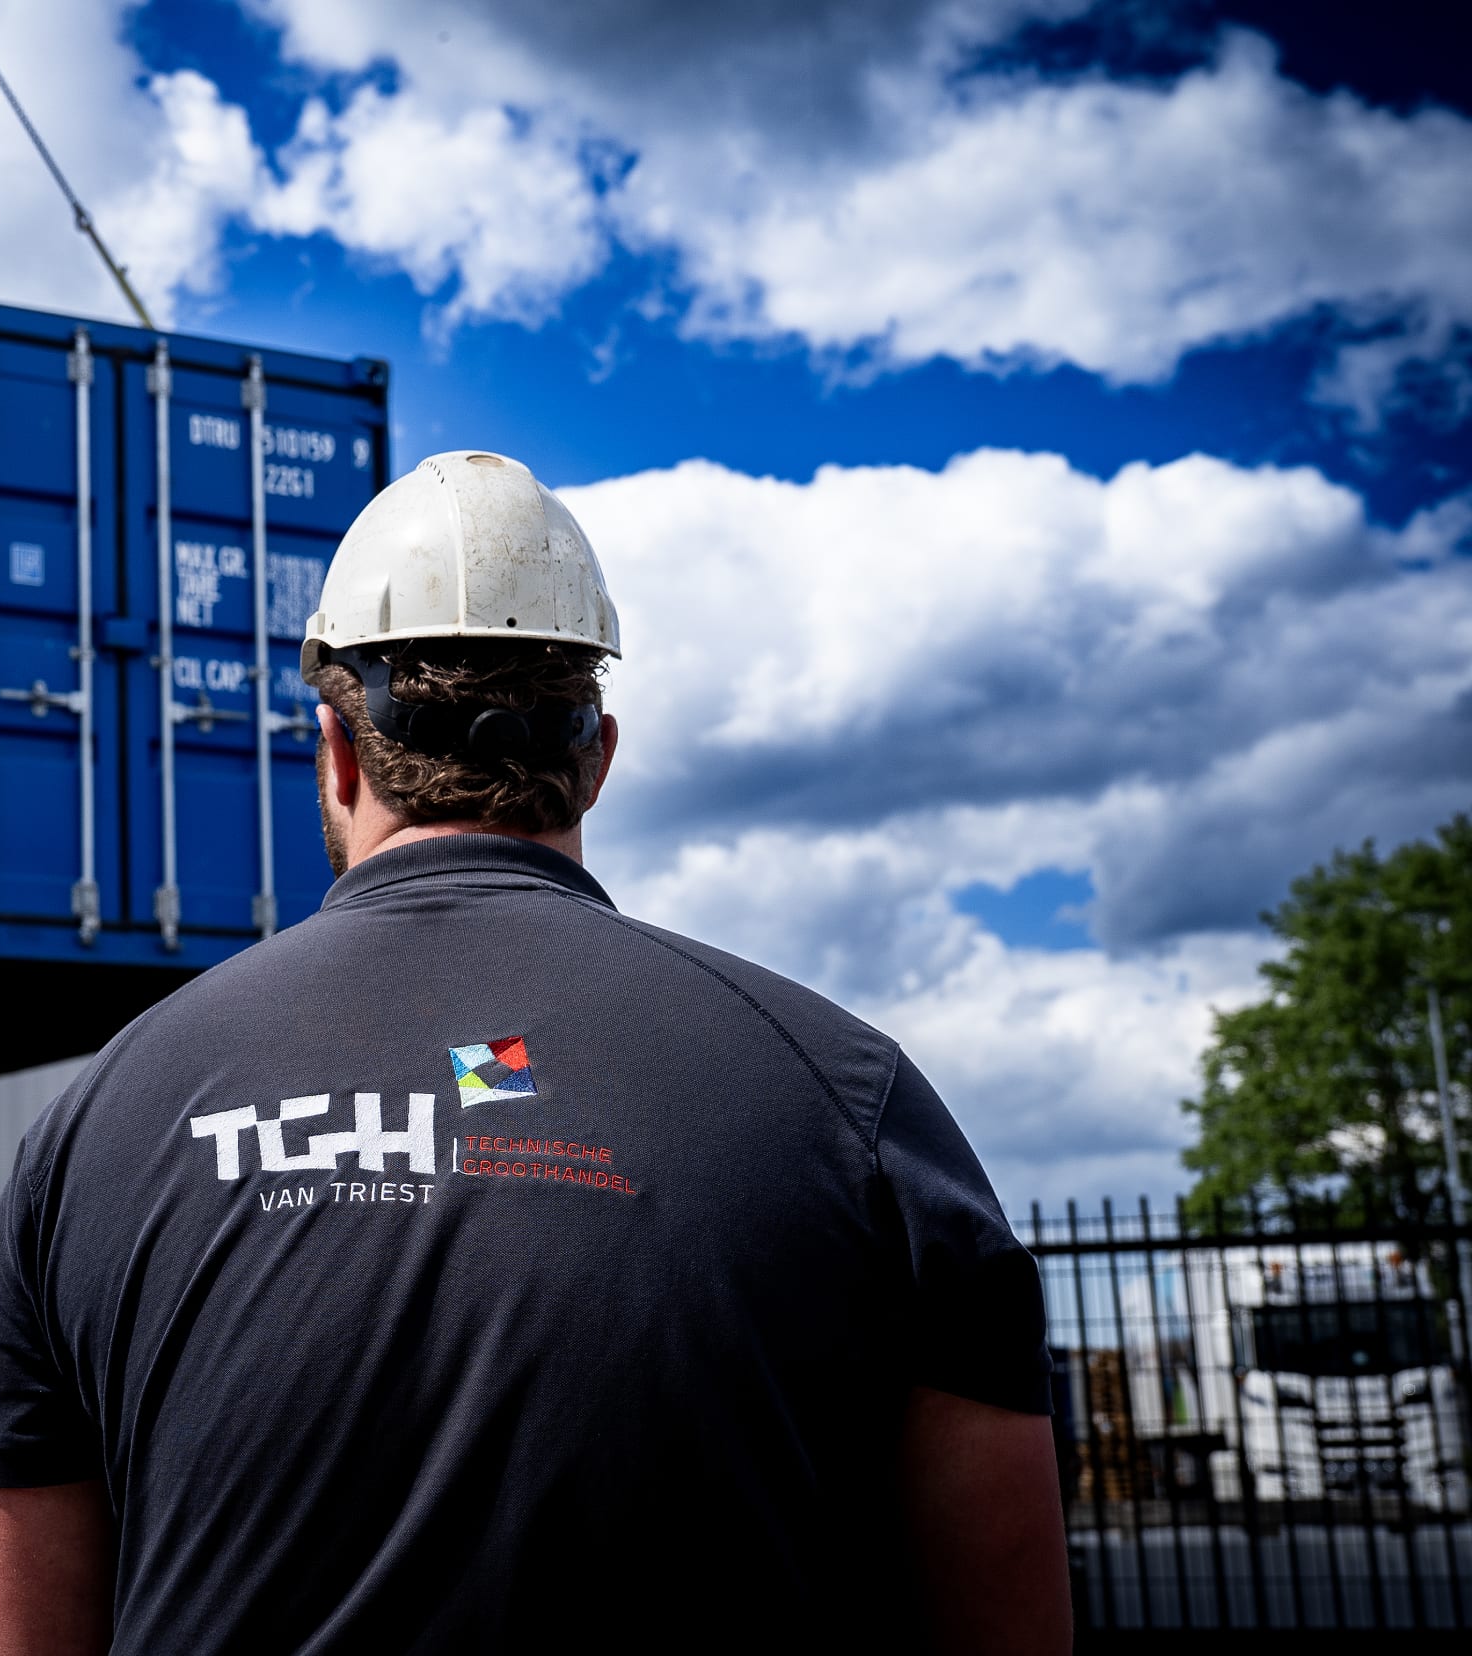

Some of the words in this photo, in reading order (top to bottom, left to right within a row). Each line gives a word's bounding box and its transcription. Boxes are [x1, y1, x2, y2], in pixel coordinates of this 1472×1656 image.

[353, 438, 370, 469] 9
[190, 1092, 436, 1180] TGH
[465, 1135, 613, 1163] TECHNISCHE
[463, 1159, 637, 1194] GROOTHANDEL
[260, 1187, 314, 1211] VAN
[330, 1183, 435, 1204] TRIEST
